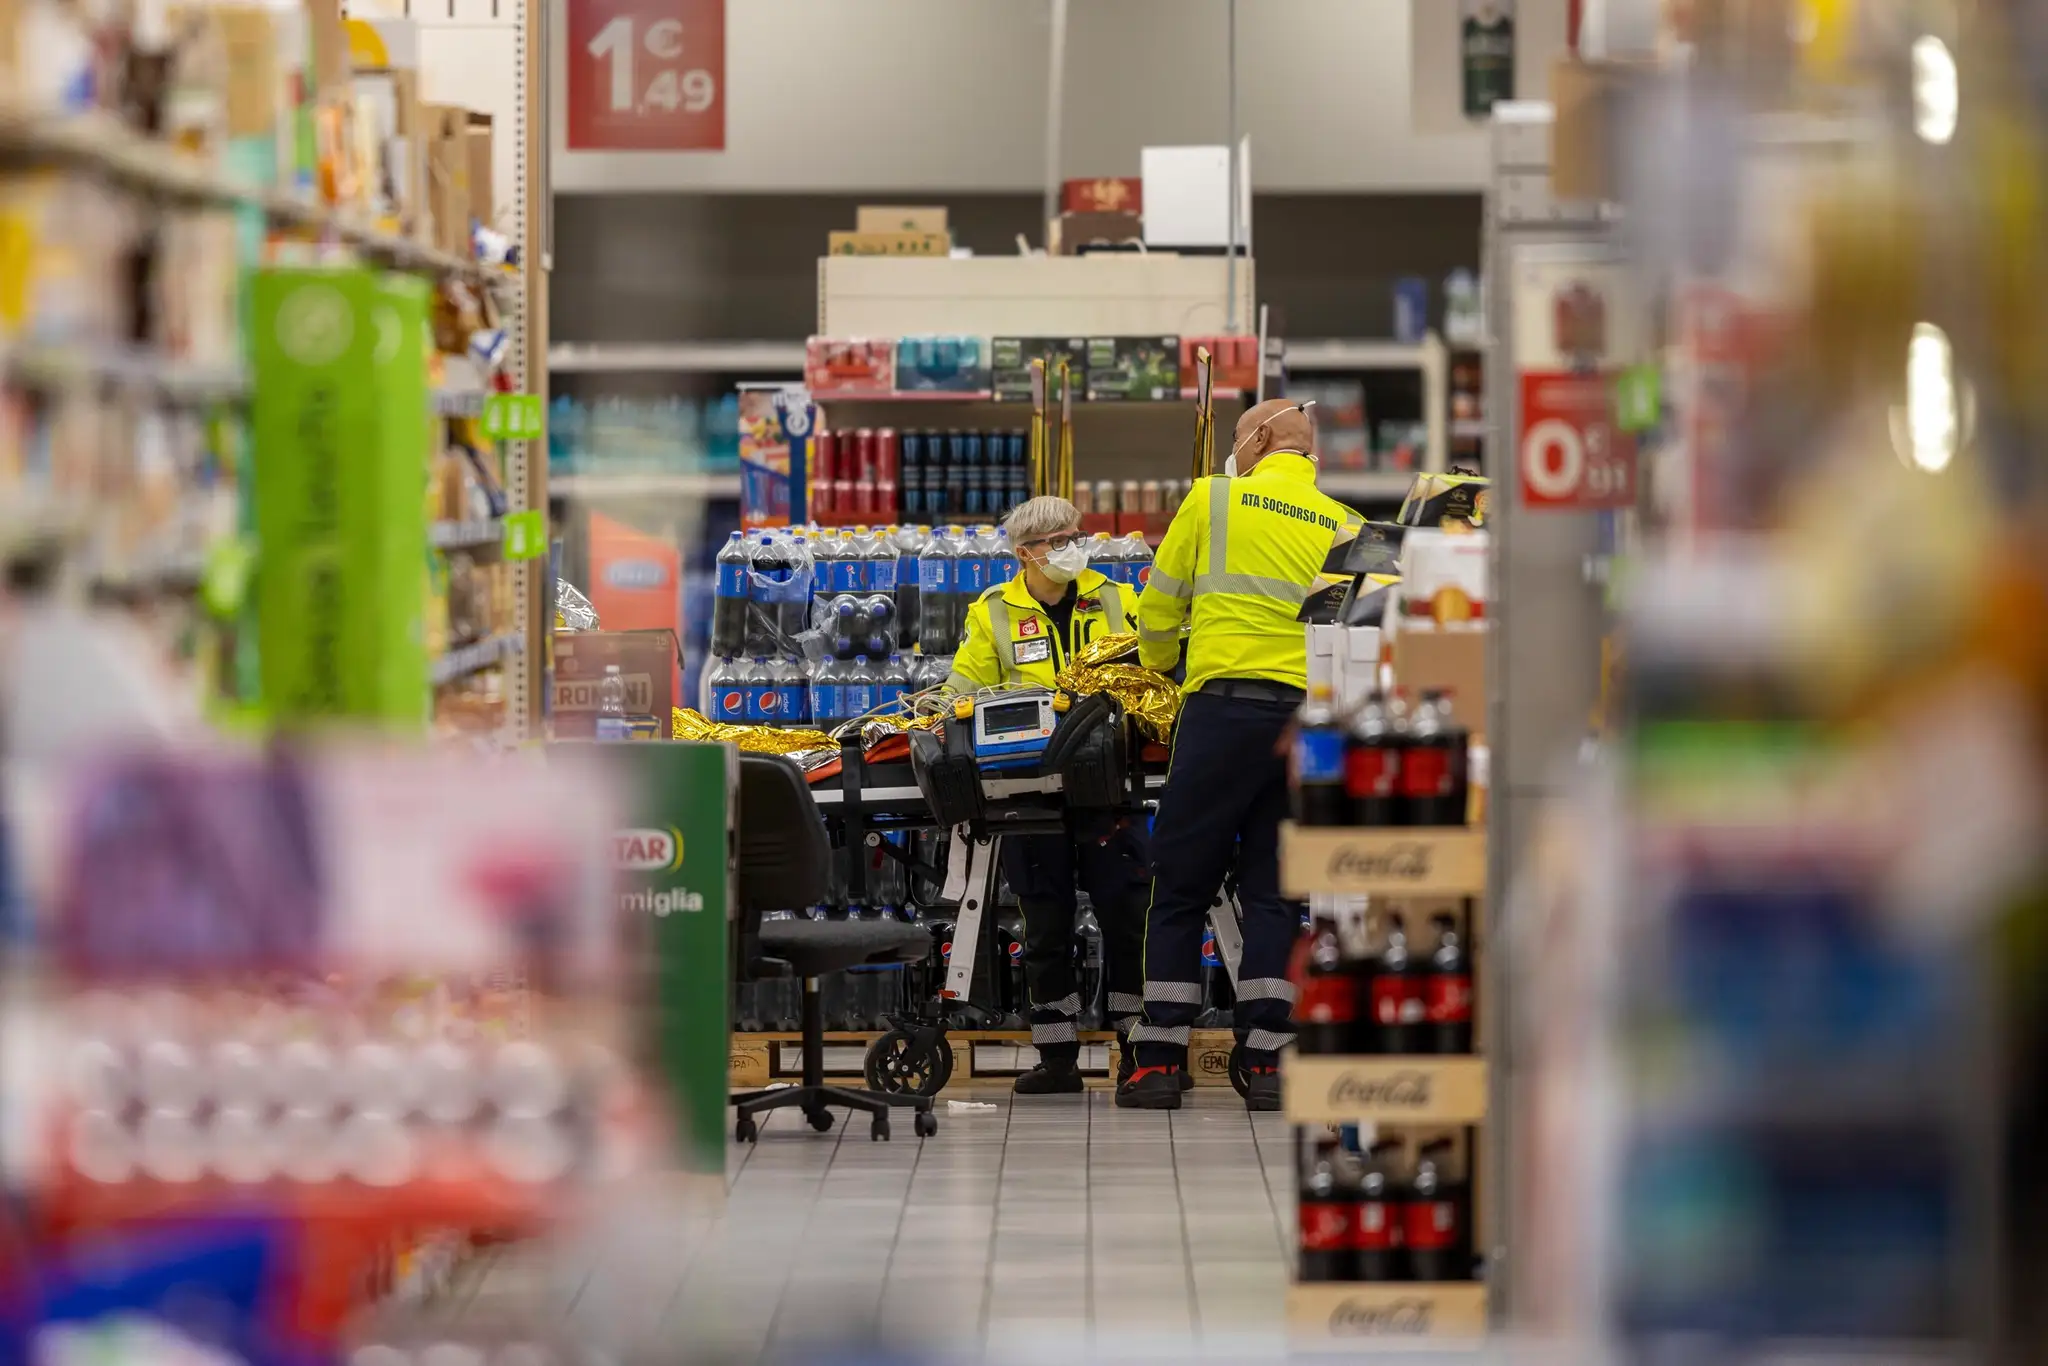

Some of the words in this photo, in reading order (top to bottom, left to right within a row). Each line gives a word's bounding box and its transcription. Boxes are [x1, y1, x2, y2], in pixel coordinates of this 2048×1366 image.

[1241, 493, 1260, 508] ATA
[1262, 496, 1316, 524] SOCCORSO
[1318, 514, 1338, 532] ODV
[782, 692, 790, 714] pepsi
[613, 835, 667, 861] TAR
[620, 887, 704, 918] miglia
